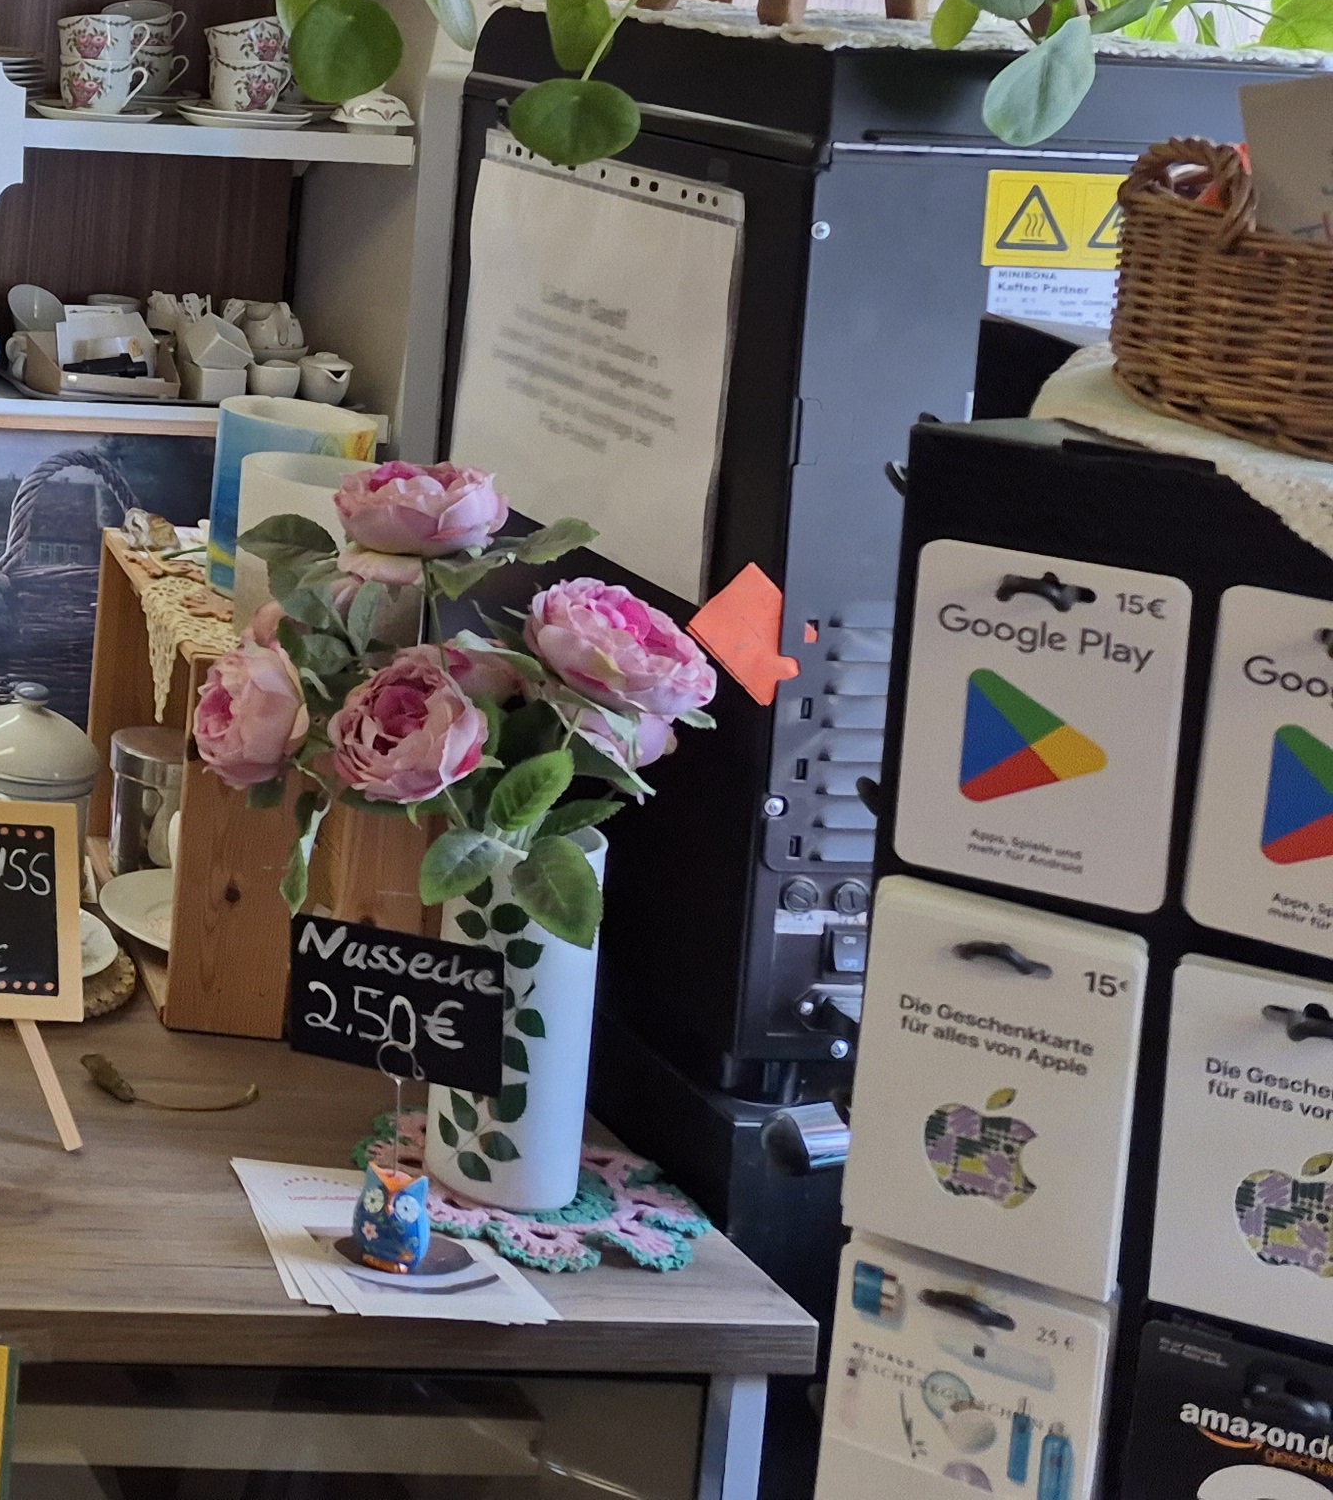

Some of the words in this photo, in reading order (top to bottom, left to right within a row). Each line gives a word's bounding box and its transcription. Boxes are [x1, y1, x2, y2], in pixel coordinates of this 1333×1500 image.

[998, 282, 1038, 293] Kaffee
[1043, 284, 1089, 295] Partner
[1116, 593, 1167, 620] 15€
[938, 603, 1067, 652] Google
[1078, 627, 1155, 674] Play
[297, 921, 505, 994] Nussecke
[899, 994, 933, 1016] Die
[937, 1004, 1094, 1057] Geschenkkarte
[901, 1015, 928, 1035] für
[932, 1024, 980, 1050] alles
[984, 1039, 1021, 1062] von
[1026, 1049, 1088, 1077] Apple
[1205, 1057, 1241, 1080] Die
[1207, 1079, 1238, 1100] für
[1244, 1089, 1293, 1113] alles
